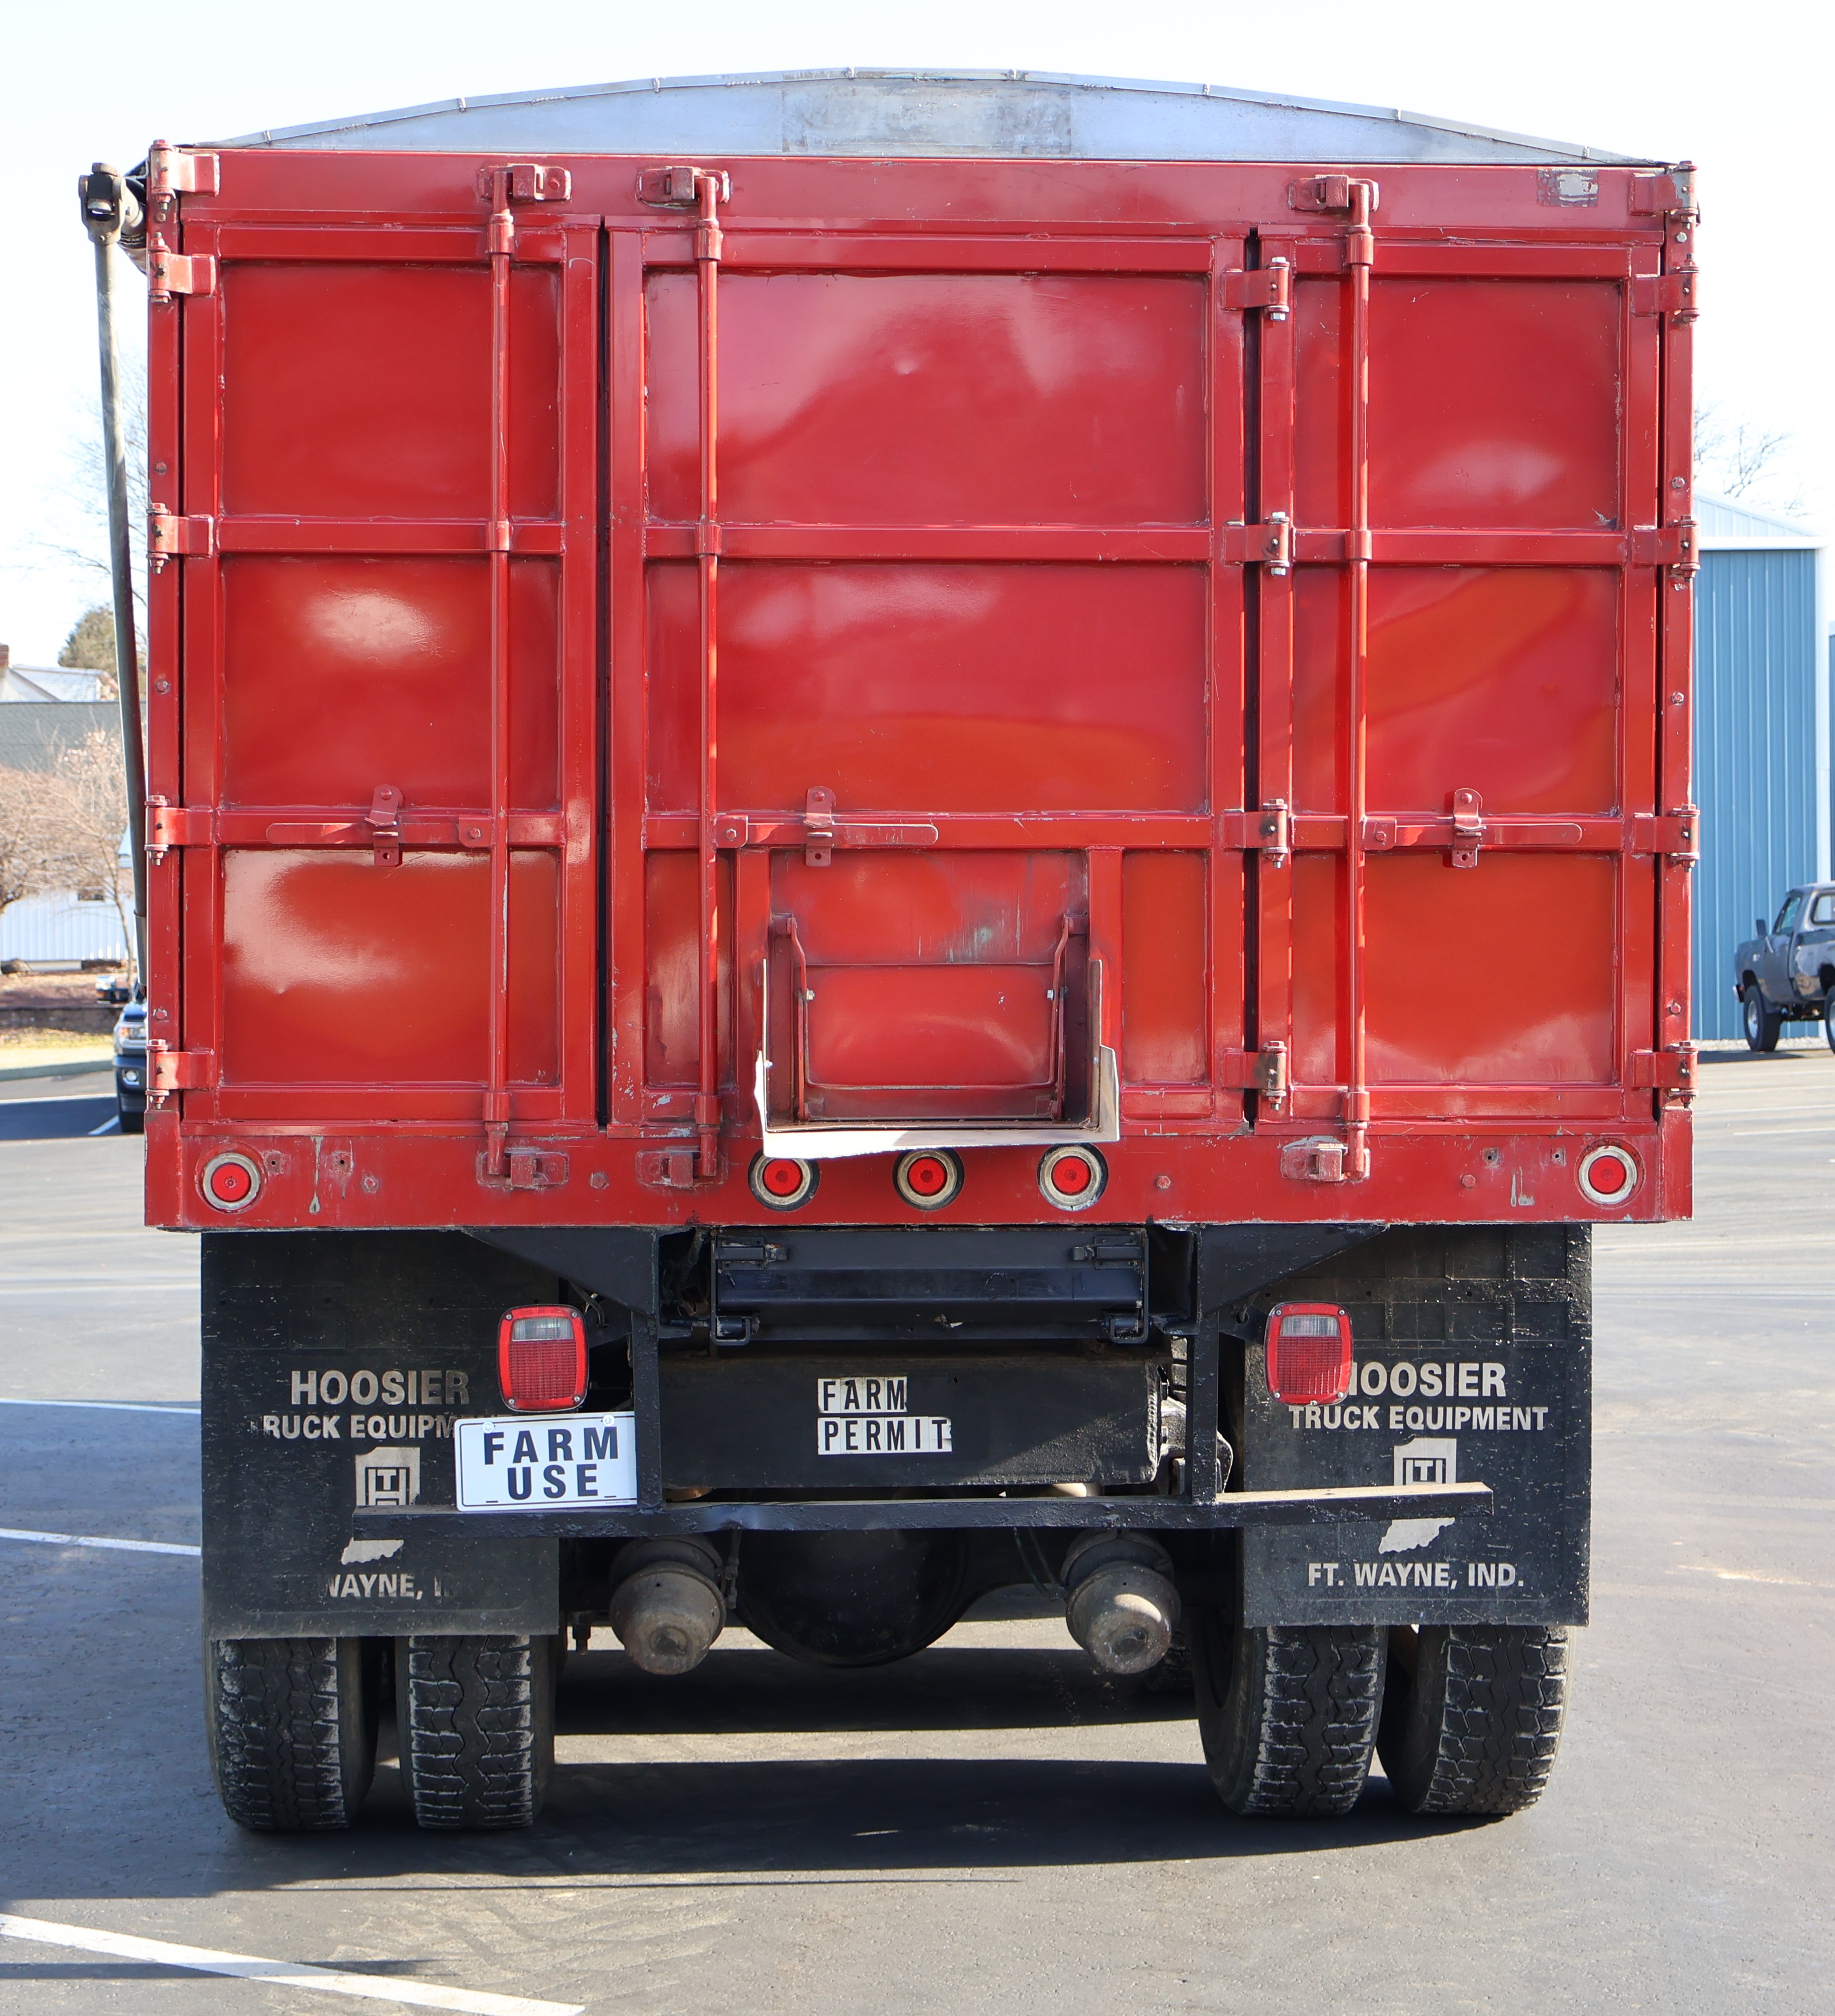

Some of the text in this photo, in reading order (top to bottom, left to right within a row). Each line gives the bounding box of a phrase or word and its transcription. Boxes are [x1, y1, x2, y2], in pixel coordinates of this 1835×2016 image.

[291, 1370, 470, 1405] HOOSIER
[823, 1379, 904, 1411] FARM
[252, 1415, 456, 1439] RUCK EQUIPM
[1289, 1406, 1548, 1430] TRUCK EQUIPMENT
[484, 1426, 618, 1465] FARM
[824, 1419, 947, 1451] PERMIT
[507, 1464, 598, 1500] USE
[1308, 1563, 1524, 1589] FT. WAYNE, IND.
